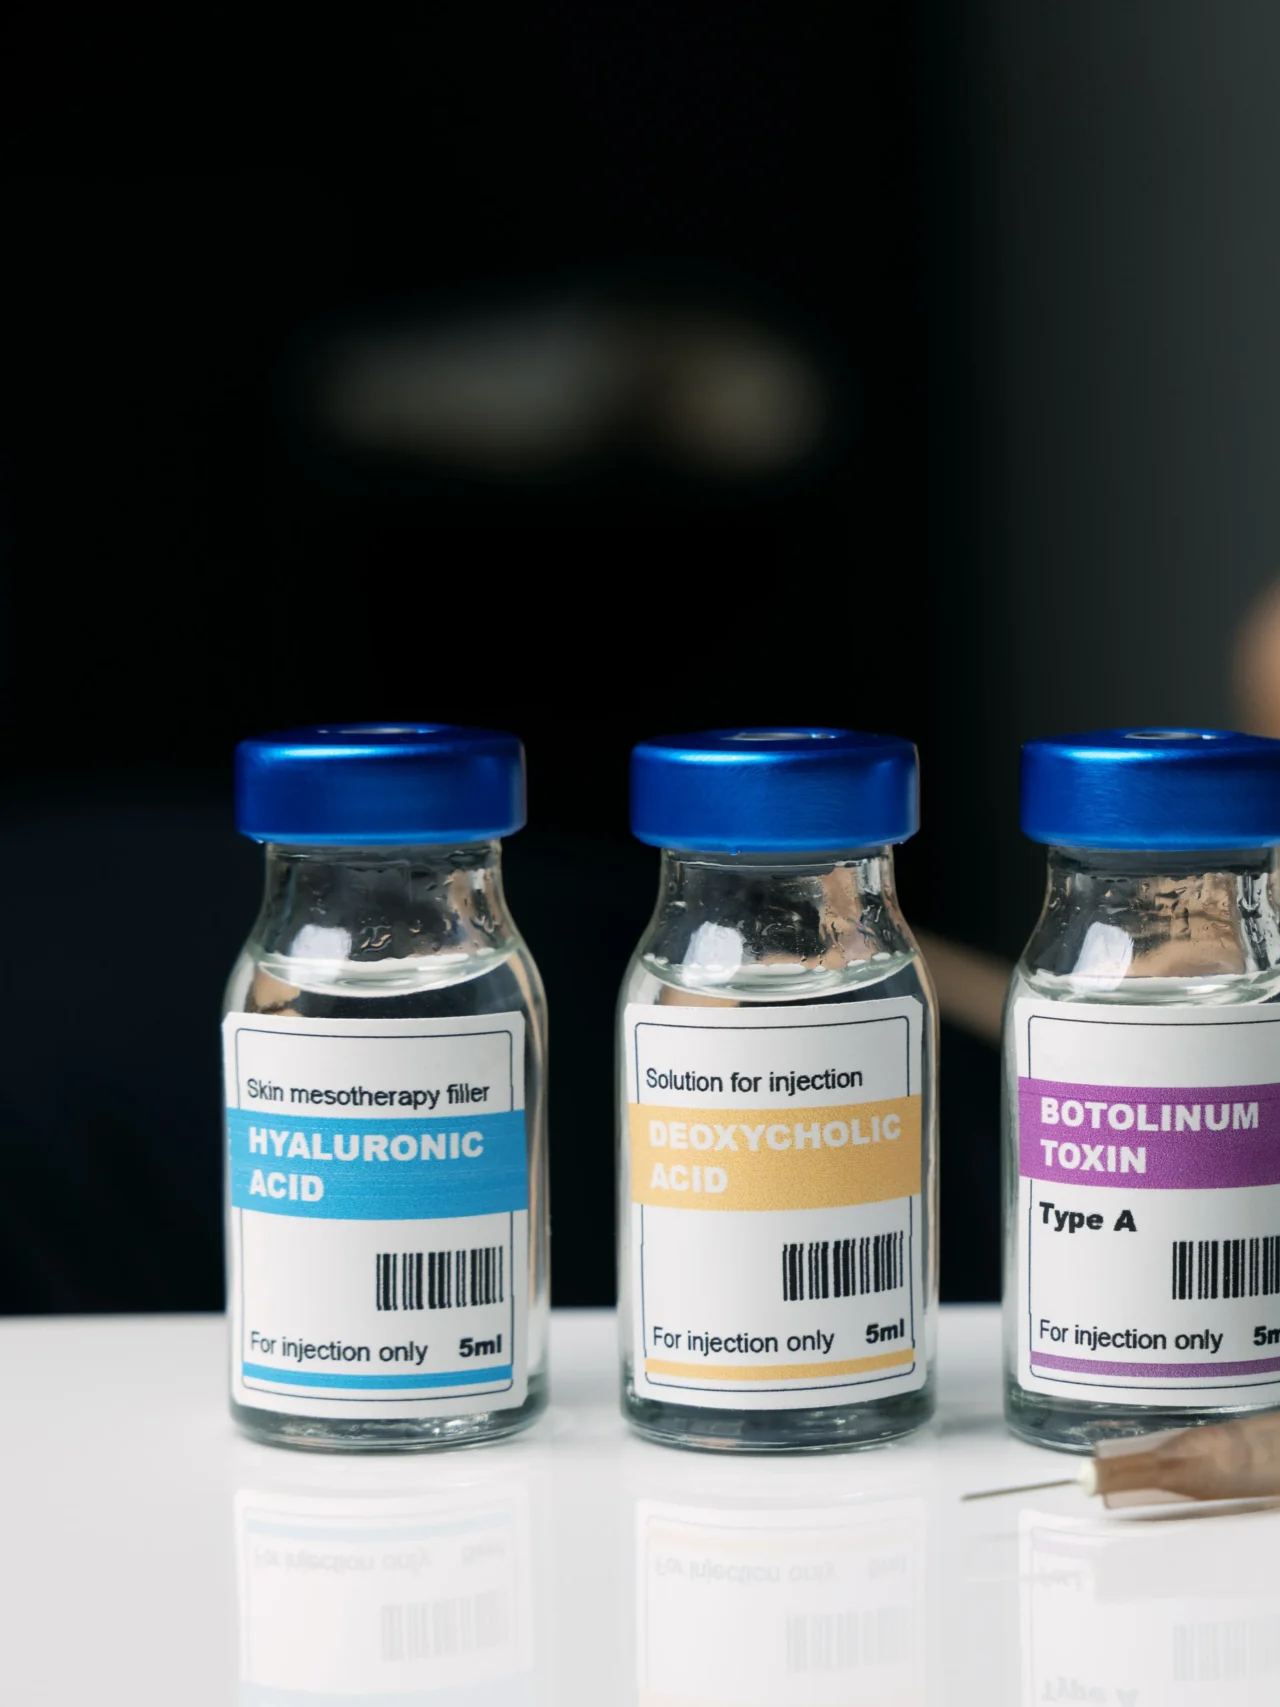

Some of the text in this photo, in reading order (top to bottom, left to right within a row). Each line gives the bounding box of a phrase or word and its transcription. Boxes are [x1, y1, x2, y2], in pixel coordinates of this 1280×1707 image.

[247, 1078, 490, 1111] Skin mesotherapy filler
[646, 1068, 863, 1096] Solution for injection
[1041, 1097, 1257, 1131] BOTOLINUM
[248, 1126, 483, 1160] HYALURONIC
[649, 1114, 901, 1151] DEOXYCHOLIC
[1040, 1139, 1146, 1173] TOXIN
[249, 1169, 323, 1201] ACID
[650, 1163, 727, 1192] ACID
[1039, 1201, 1138, 1234] Type A
[459, 1334, 502, 1358] 5ml
[653, 1326, 835, 1356] For injection only
[866, 1318, 904, 1344] 5ml
[1040, 1319, 1223, 1354] For injection only
[251, 1331, 428, 1366] For injection only
